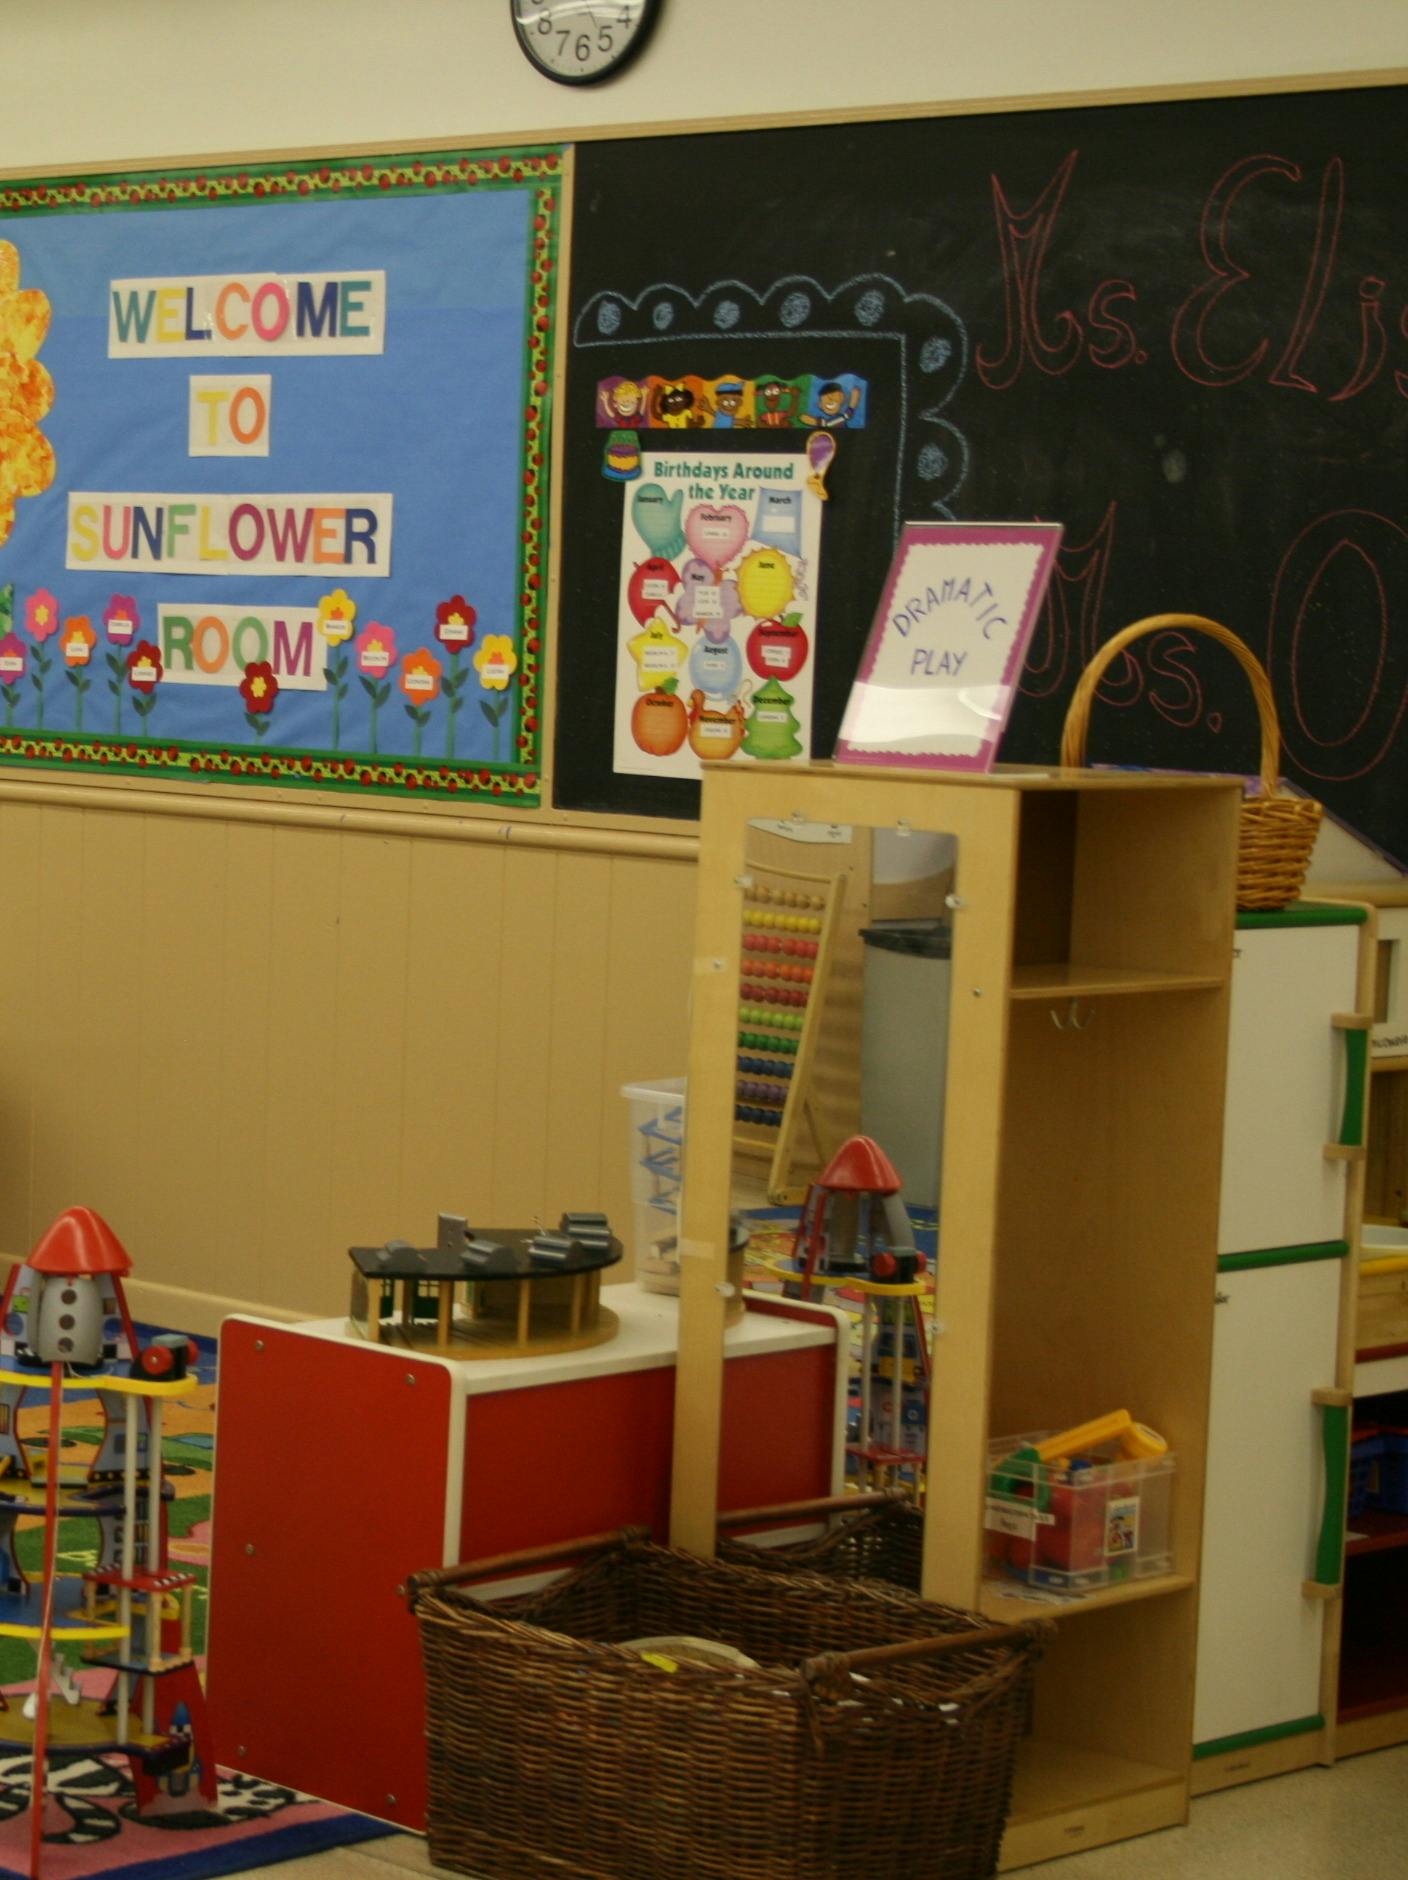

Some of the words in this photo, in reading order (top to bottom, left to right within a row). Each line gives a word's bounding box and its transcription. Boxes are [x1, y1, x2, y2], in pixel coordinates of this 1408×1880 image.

[537, 10, 553, 36] 8
[616, 5, 632, 30] 4
[555, 29, 571, 57] 7
[575, 34, 592, 62] 6
[596, 25, 614, 53] 5
[976, 149, 1149, 390] Ms.
[1170, 154, 1408, 401] Eli
[112, 280, 372, 343] WELCOME
[196, 386, 266, 445] TO
[654, 461, 729, 481] Birthdays
[733, 463, 794, 480] Around
[689, 484, 715, 500] the
[719, 483, 756, 500] Year
[768, 496, 792, 505] March
[700, 512, 733, 523] February
[71, 503, 379, 565] SUNFLOWER
[691, 573, 706, 583] May
[892, 576, 1008, 640] DRAMATIC
[162, 616, 314, 678] ROOM
[703, 645, 729, 656] August
[910, 648, 968, 677] PLAY
